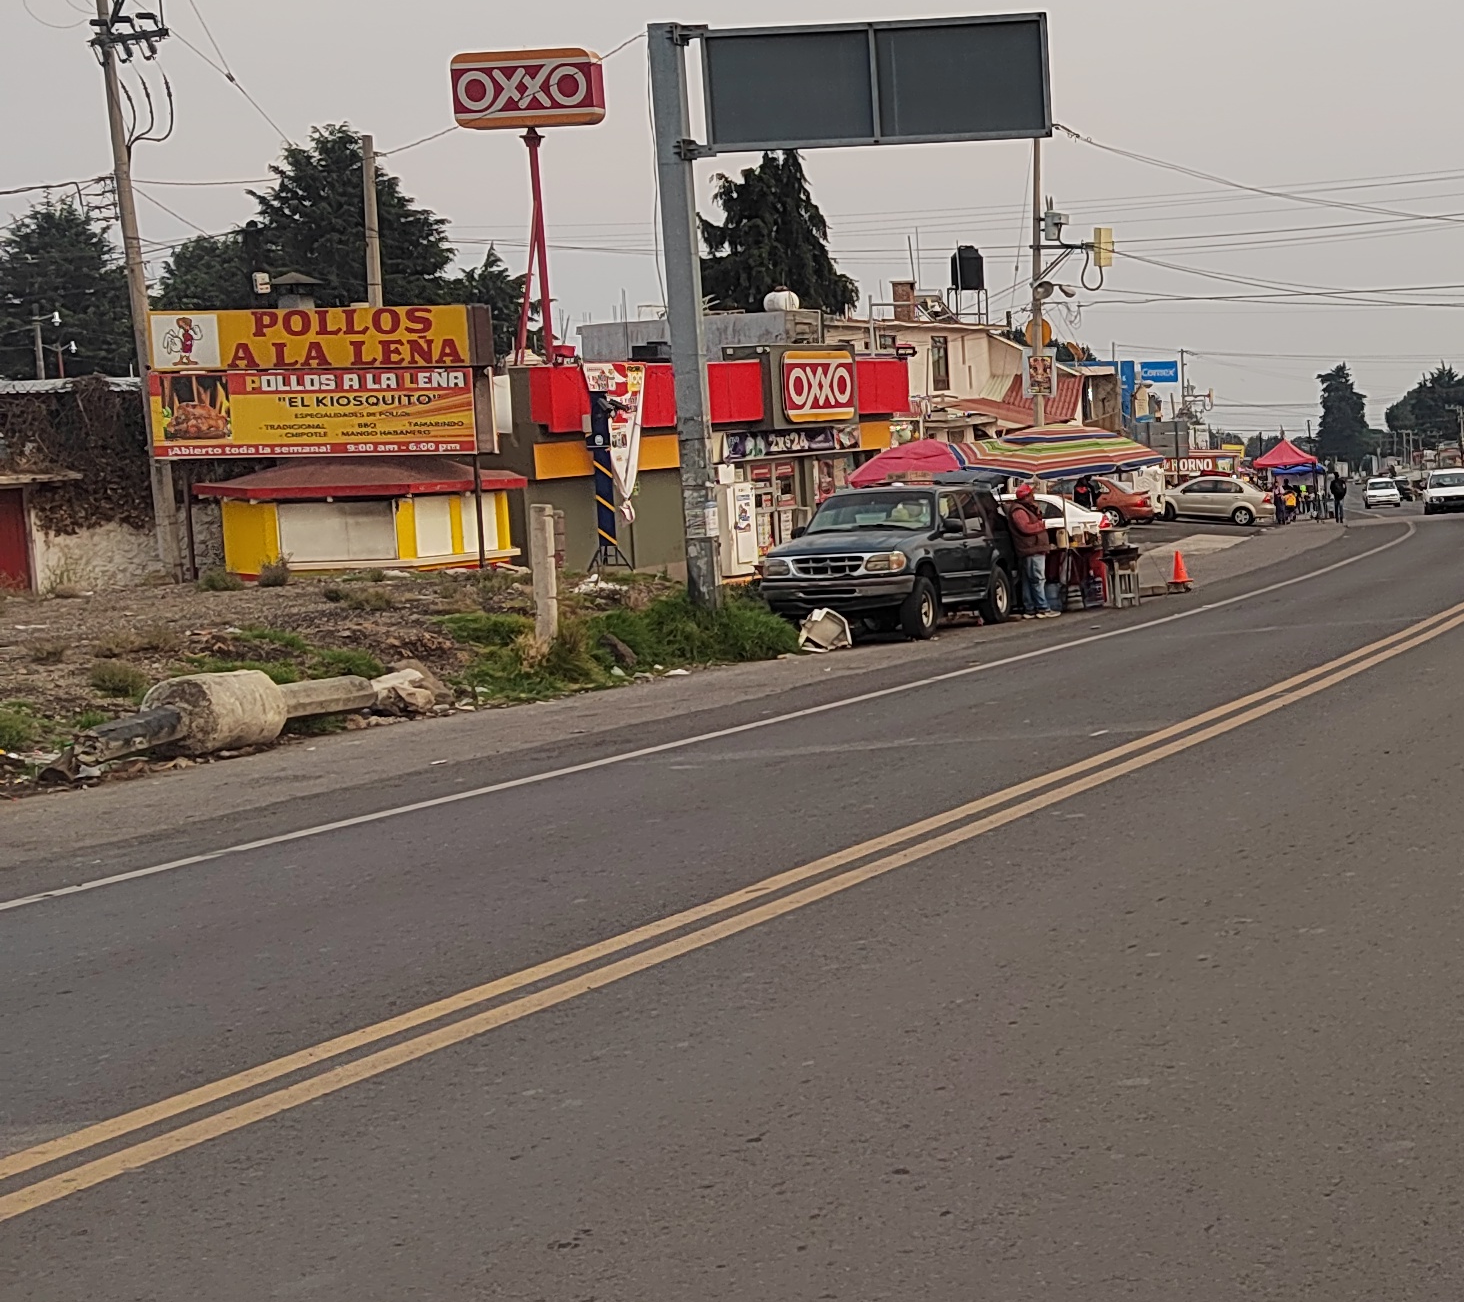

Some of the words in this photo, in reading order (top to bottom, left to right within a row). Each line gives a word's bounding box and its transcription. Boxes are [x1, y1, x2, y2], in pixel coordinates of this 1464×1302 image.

[457, 60, 587, 113] OXXO
[251, 307, 433, 337] POLLOS
[227, 342, 260, 367] A
[271, 341, 332, 367] LA
[349, 335, 465, 366] LEÑA
[1141, 367, 1176, 377] Comex
[245, 374, 336, 391] POLLOS
[343, 373, 360, 389] A
[366, 372, 397, 389] LA
[403, 368, 465, 388] LEÑA
[789, 365, 851, 410] OXXO
[278, 396, 310, 407] "EL
[315, 393, 440, 408] KIOSQUITO"
[294, 411, 365, 419] ESPECIALIDADES
[264, 423, 326, 431] TRADICIONAL
[407, 420, 464, 428] TAMARINDO
[341, 429, 378, 437] MANGO
[379, 429, 431, 437] HABANERO
[168, 445, 222, 456] ¡Abierto
[225, 445, 255, 454] toda
[259, 445, 271, 454] la
[274, 444, 331, 454] semana!
[346, 443, 374, 452] 9:00
[377, 444, 398, 452] am
[438, 443, 461, 452] pm
[1171, 458, 1213, 471] HORNO
